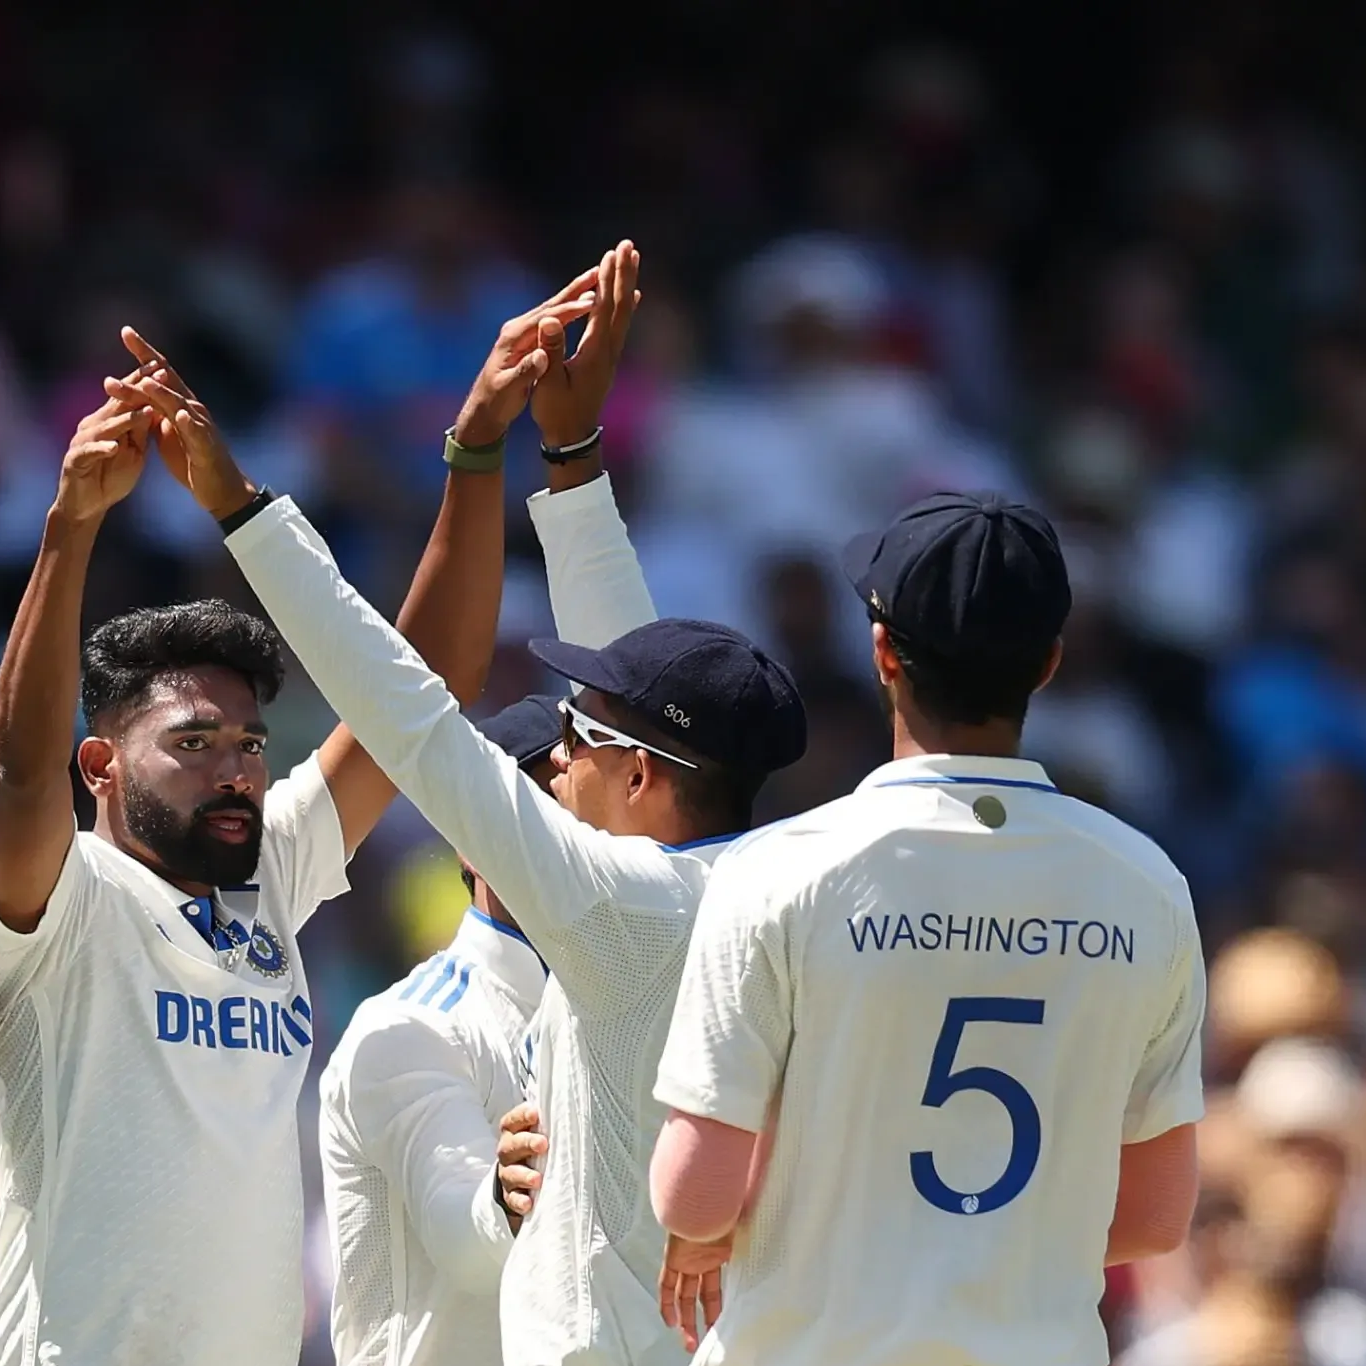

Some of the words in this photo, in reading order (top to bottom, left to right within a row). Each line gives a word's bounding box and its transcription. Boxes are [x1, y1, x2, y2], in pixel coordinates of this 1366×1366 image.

[663, 703, 691, 729] 306
[846, 912, 1135, 964] WASHINGTON
[909, 996, 1047, 1216] 5
